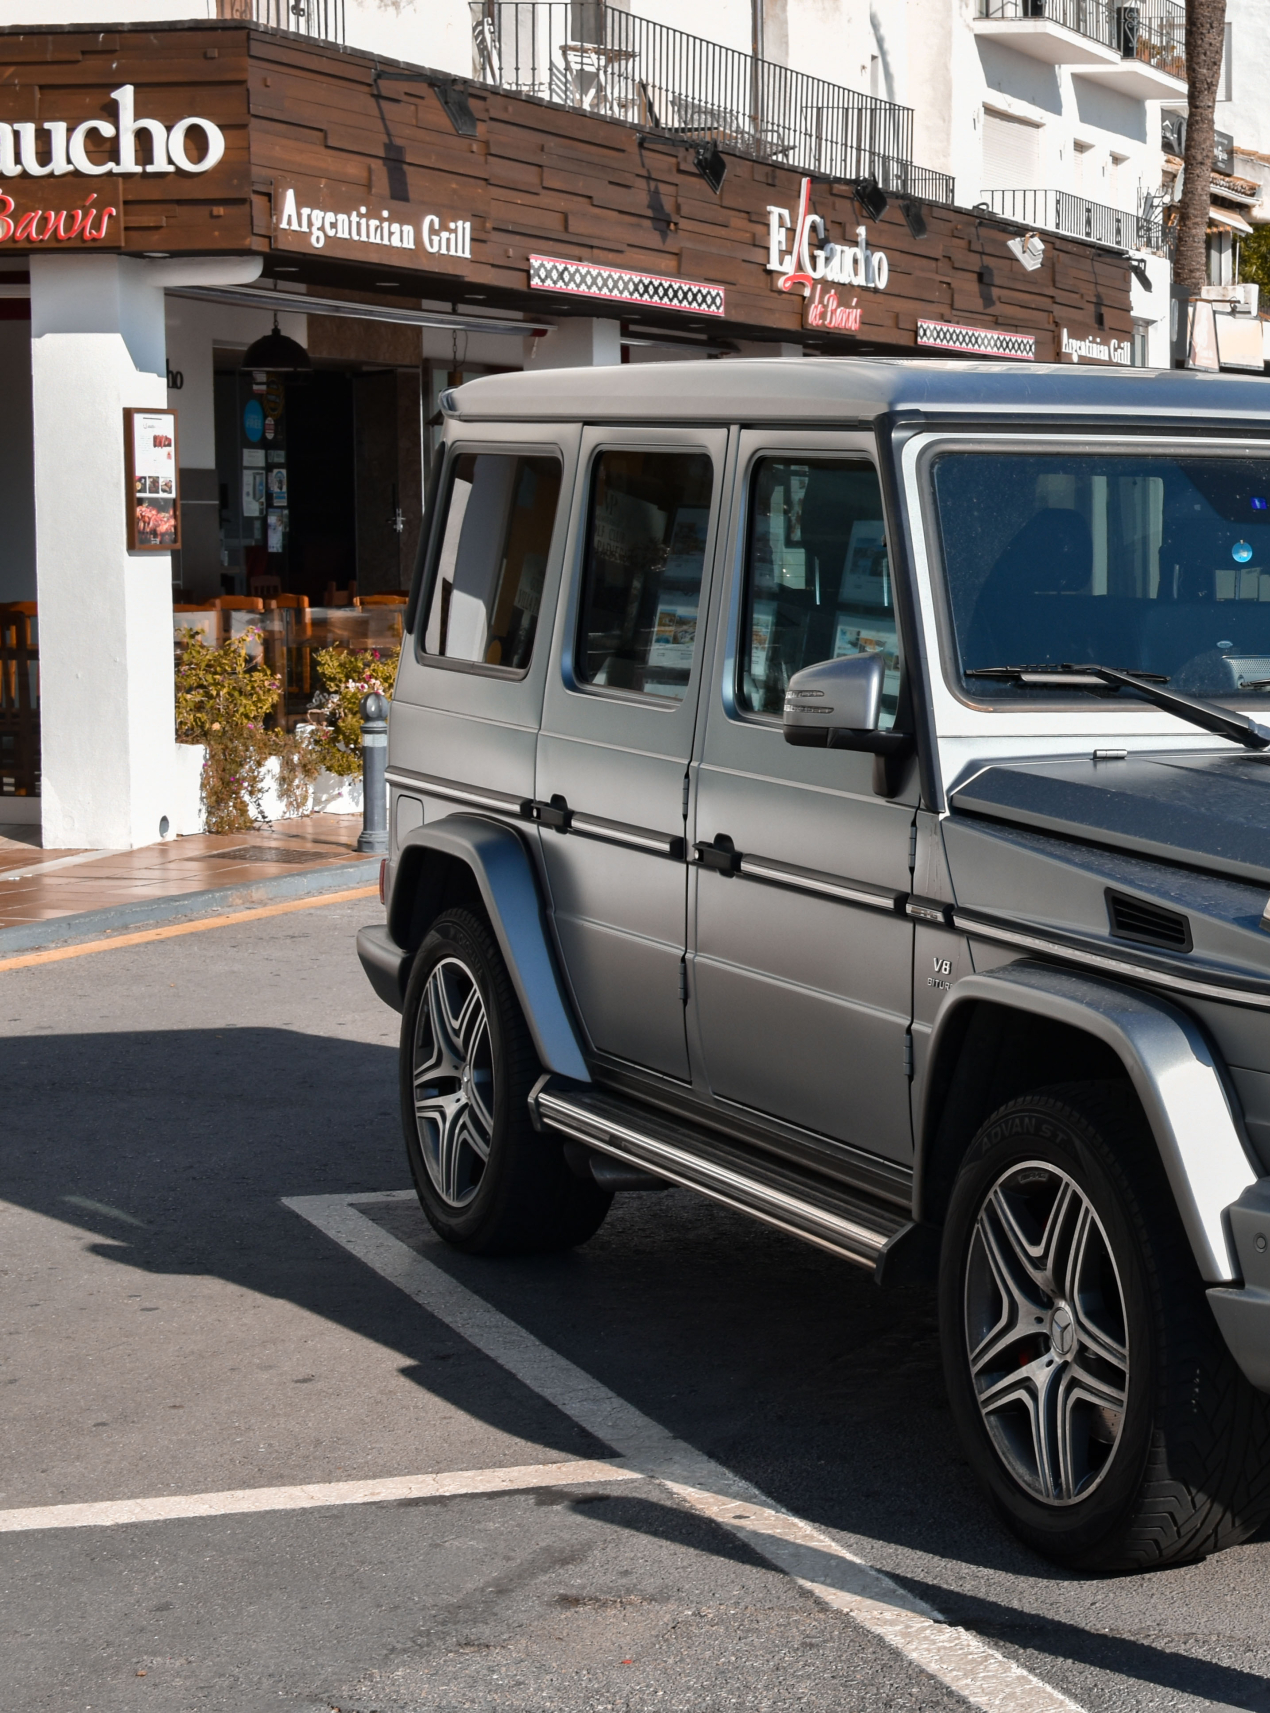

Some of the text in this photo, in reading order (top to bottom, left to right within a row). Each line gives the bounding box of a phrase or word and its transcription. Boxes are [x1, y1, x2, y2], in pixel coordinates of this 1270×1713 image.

[279, 188, 472, 259] Argentinian Grill
[800, 214, 889, 290] Gaucho
[1062, 327, 1131, 365] Argentinian Grill
[927, 977, 953, 991] BITUR
[933, 957, 951, 975] V8
[982, 1117, 1035, 1155] ADVAN
